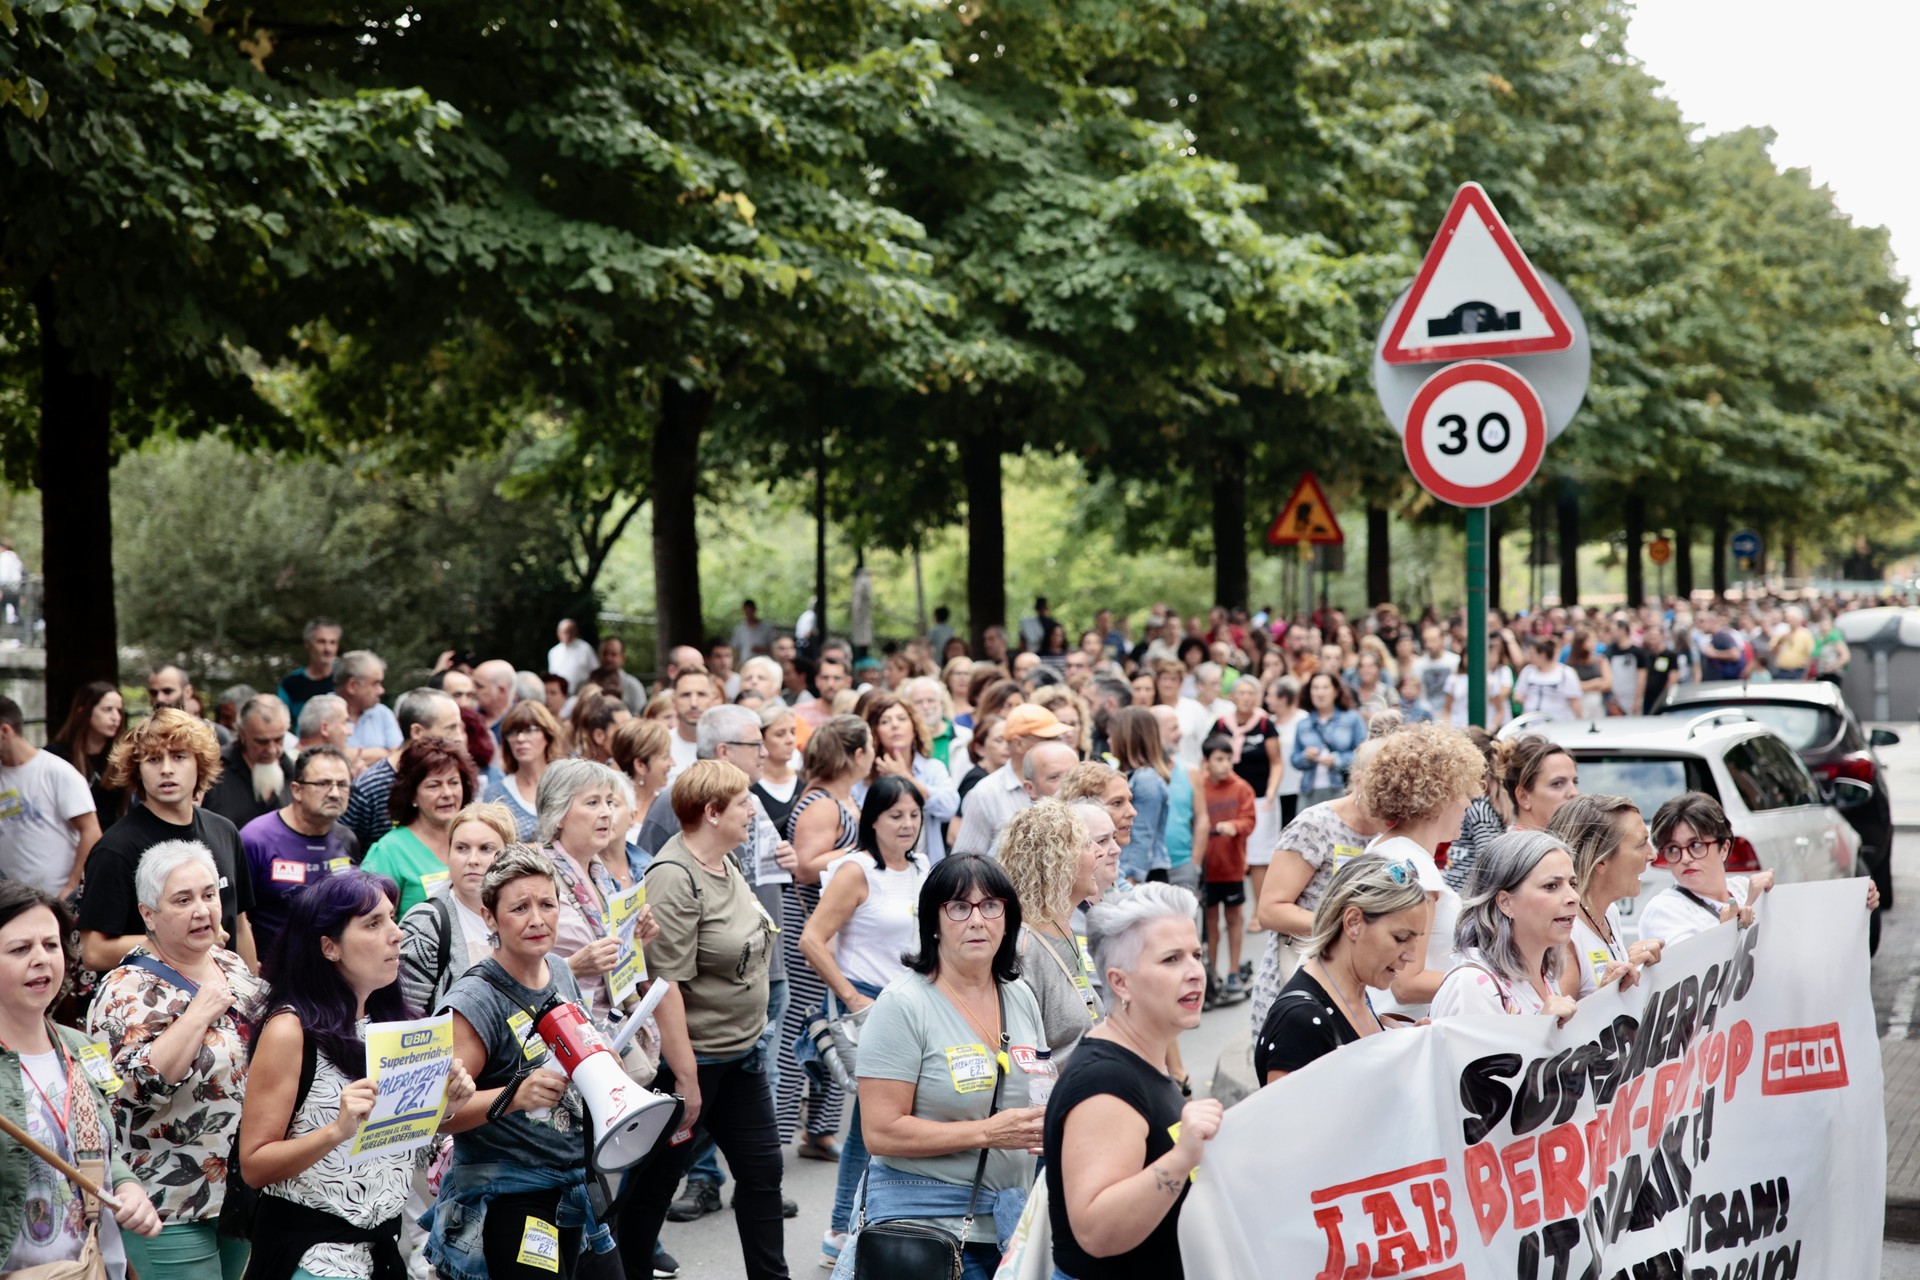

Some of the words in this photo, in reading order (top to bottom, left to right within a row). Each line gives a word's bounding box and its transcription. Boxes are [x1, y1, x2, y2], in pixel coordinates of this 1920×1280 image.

[1437, 412, 1511, 455] 30
[413, 1031, 431, 1046] BM
[1767, 1037, 1840, 1082] CCOO
[1312, 1177, 1458, 1280] LAB
